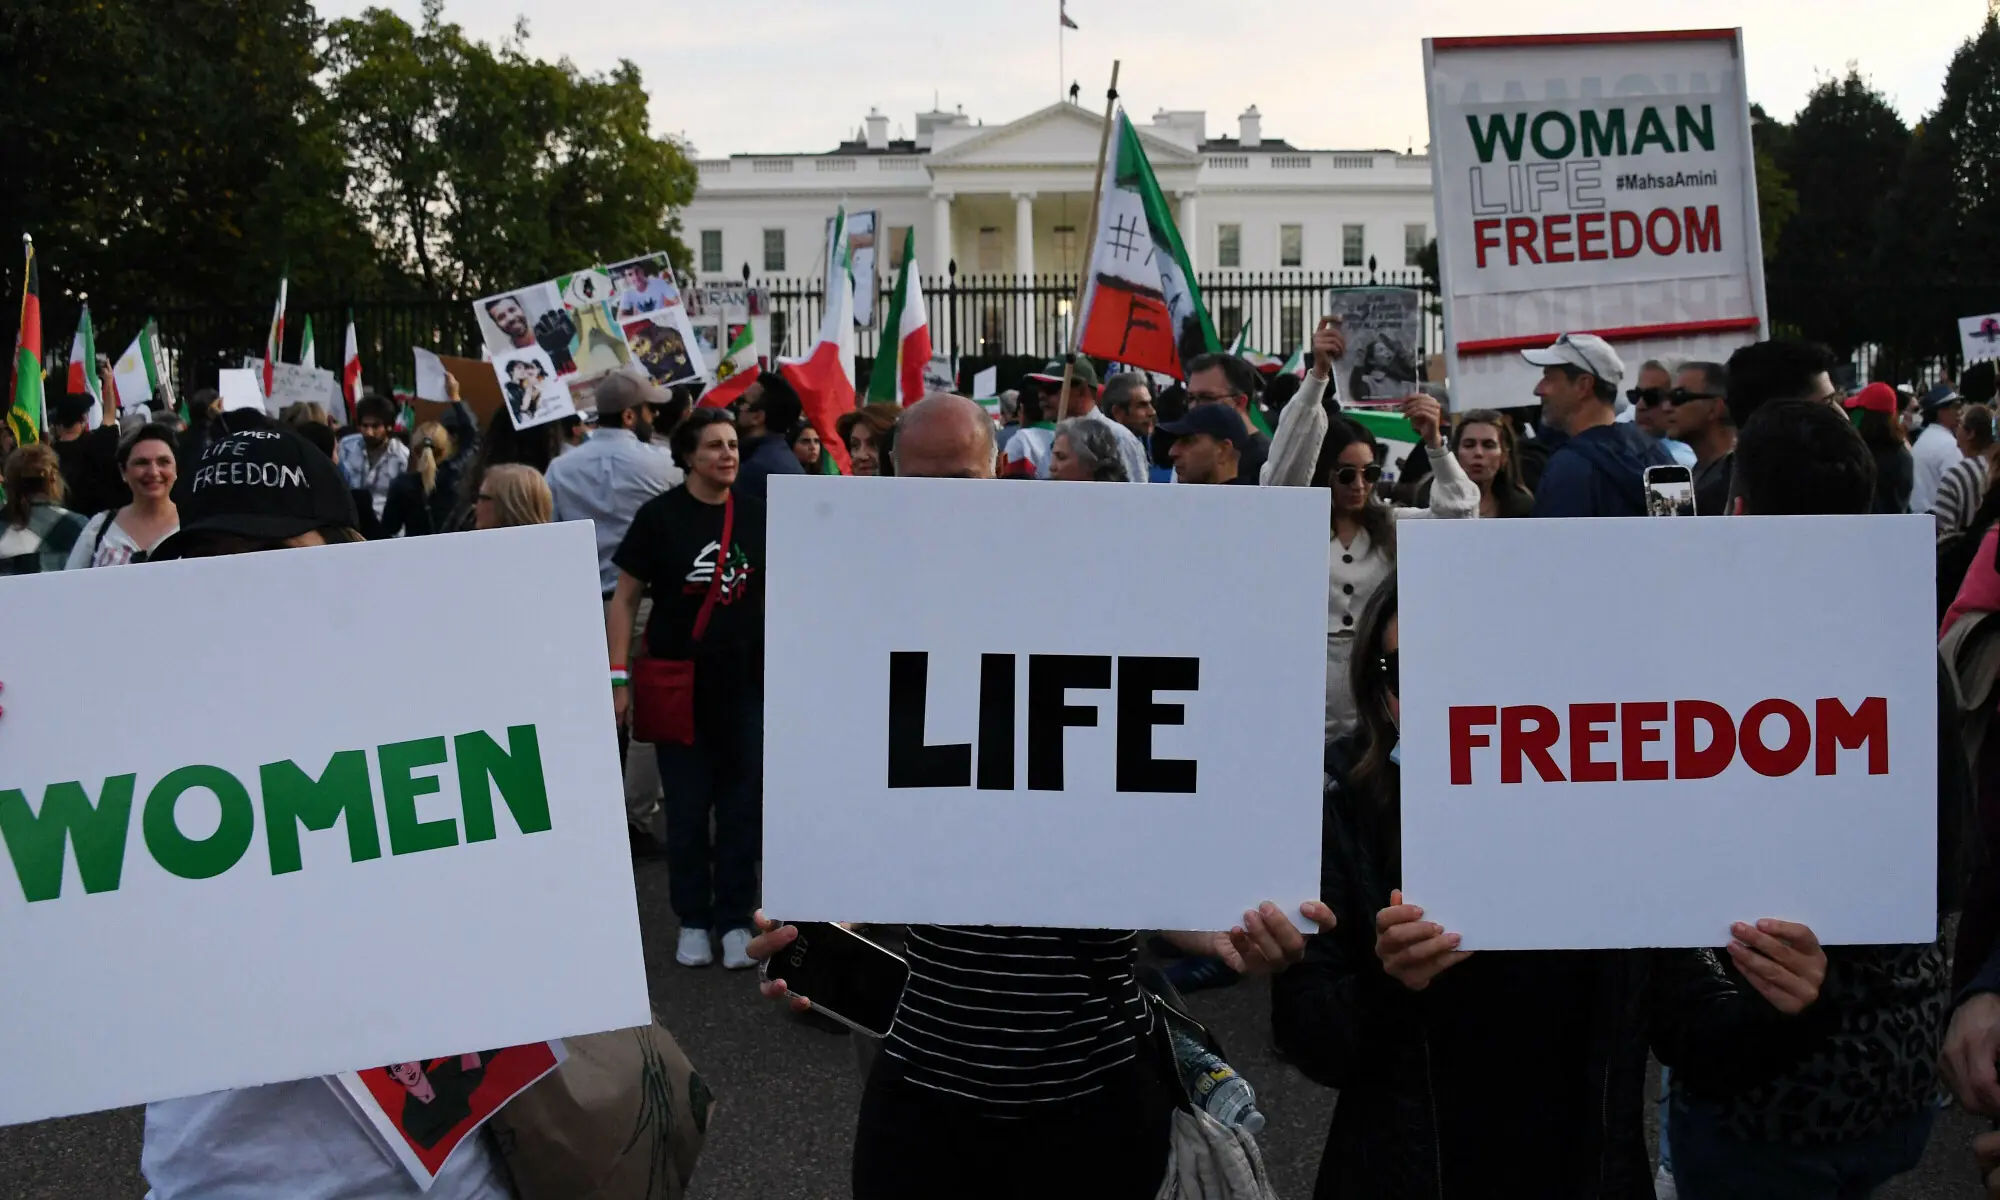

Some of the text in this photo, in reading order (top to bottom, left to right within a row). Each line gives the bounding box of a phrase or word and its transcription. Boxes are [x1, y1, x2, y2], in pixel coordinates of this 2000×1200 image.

[1466, 104, 1715, 163] WOMAN
[1468, 159, 1606, 216] LIFE
[1616, 169, 1718, 191] #MahsaAmini
[1474, 205, 1721, 268] FREEDOM
[193, 462, 310, 493] FREEDOM
[201, 440, 250, 461] LIFE
[888, 652, 1200, 794] LIFE
[1449, 697, 1889, 785] FREEDOM
[0, 724, 552, 903] WOMEN
